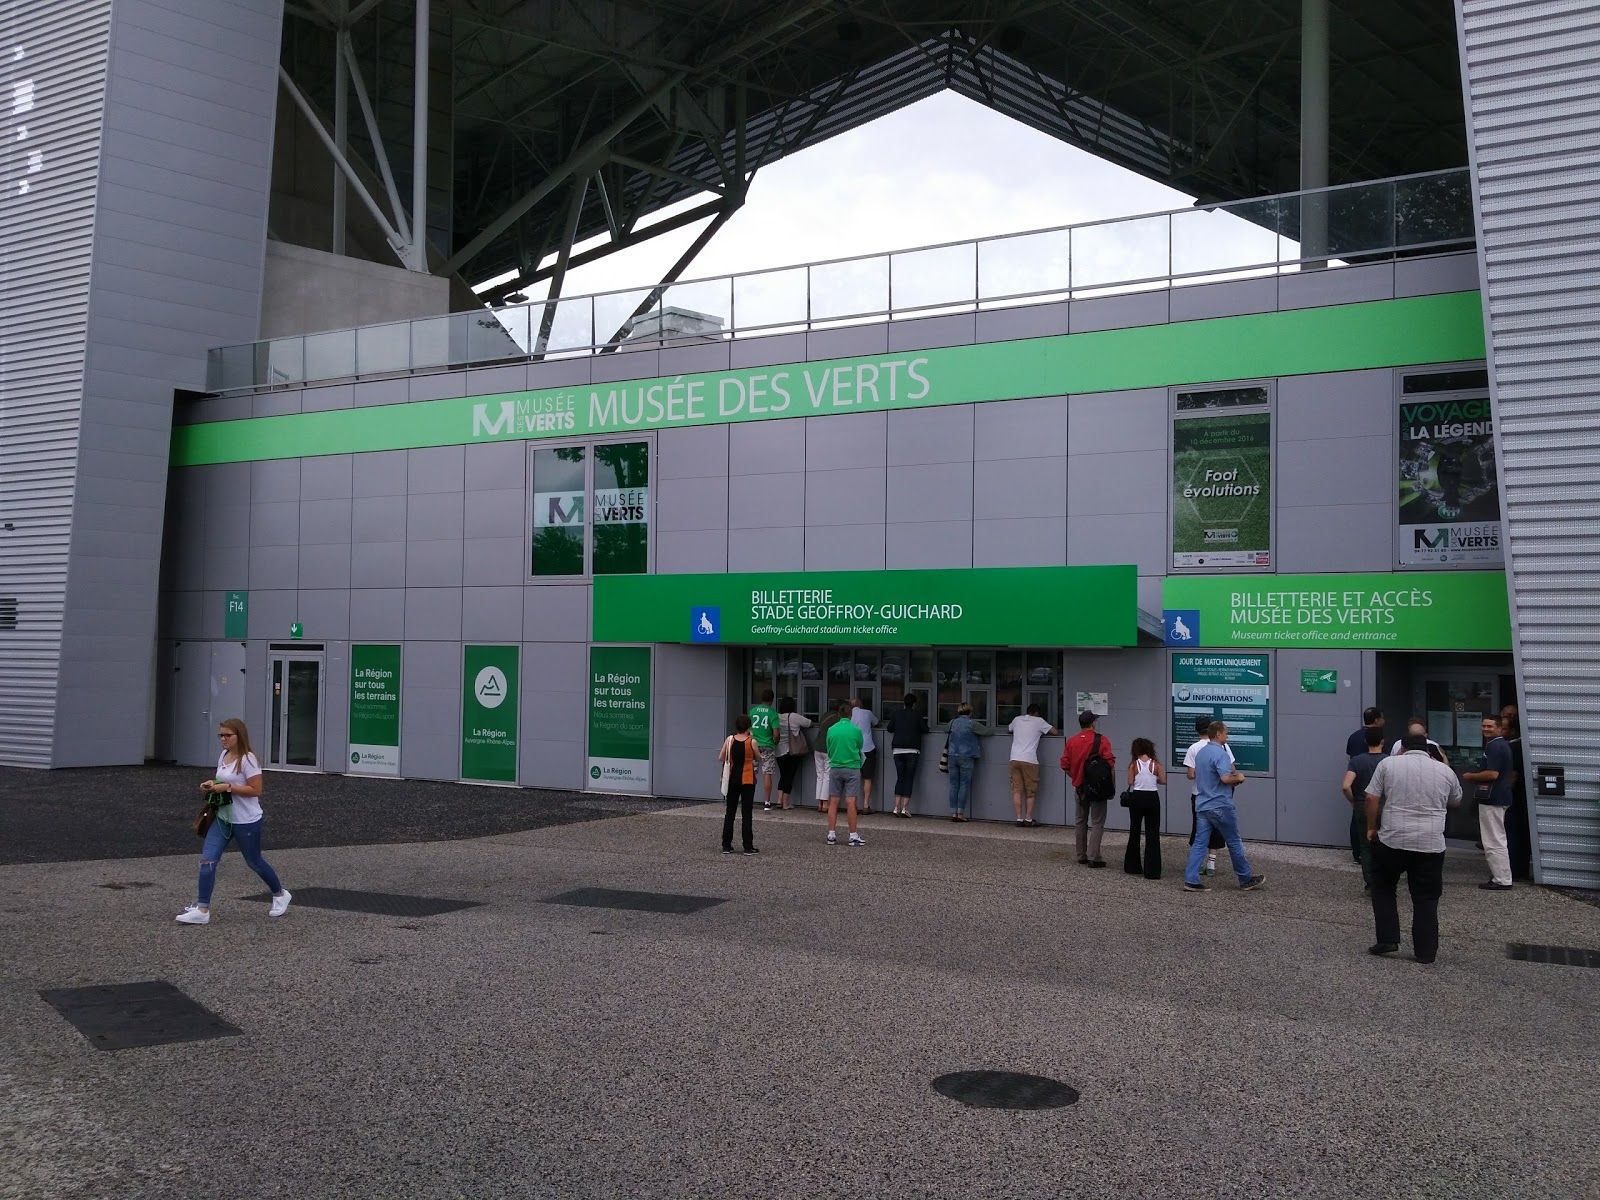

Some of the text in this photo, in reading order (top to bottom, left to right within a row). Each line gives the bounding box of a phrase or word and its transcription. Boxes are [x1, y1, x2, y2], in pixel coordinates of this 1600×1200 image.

[588, 358, 930, 428] MUSÉE DES VERTS
[517, 393, 575, 414] MUSÉE
[525, 411, 575, 432] VERTS
[1410, 425, 1430, 440] LA
[1199, 437, 1236, 445] décembre
[1205, 468, 1238, 482] Foot
[1183, 483, 1260, 498] évolutions
[595, 490, 644, 506] MUSÉE
[602, 506, 644, 522] VERTS
[1450, 525, 1499, 537] MUSÉE
[1458, 536, 1499, 548] VERTS
[751, 589, 833, 604] BILLETTERIE
[1231, 588, 1433, 608] BILLETTERIE ET ACCÈS
[229, 601, 244, 612] F14
[751, 604, 963, 620] STADE GEOFFROY-GUICHARD
[1231, 607, 1395, 624] MUSÉE DES VERTS
[751, 624, 898, 635] Geoffroy-Guichard stadium ticket office
[1231, 630, 1398, 640] Museum ticket office and entrance
[1179, 658, 1262, 667] JOUR DE MATCH UNIQUEMENT
[354, 668, 393, 679] La Région
[594, 673, 641, 685] La Région
[354, 680, 385, 689] sur tous
[354, 690, 396, 701] les terrains
[594, 686, 632, 696] sur tous
[1214, 688, 1262, 696] BILLETTERIE
[593, 697, 646, 709] les terrains
[1192, 694, 1254, 703] INFORMATIONS
[751, 714, 769, 729] 24
[473, 728, 507, 738] La Région
[611, 767, 632, 776] Région
